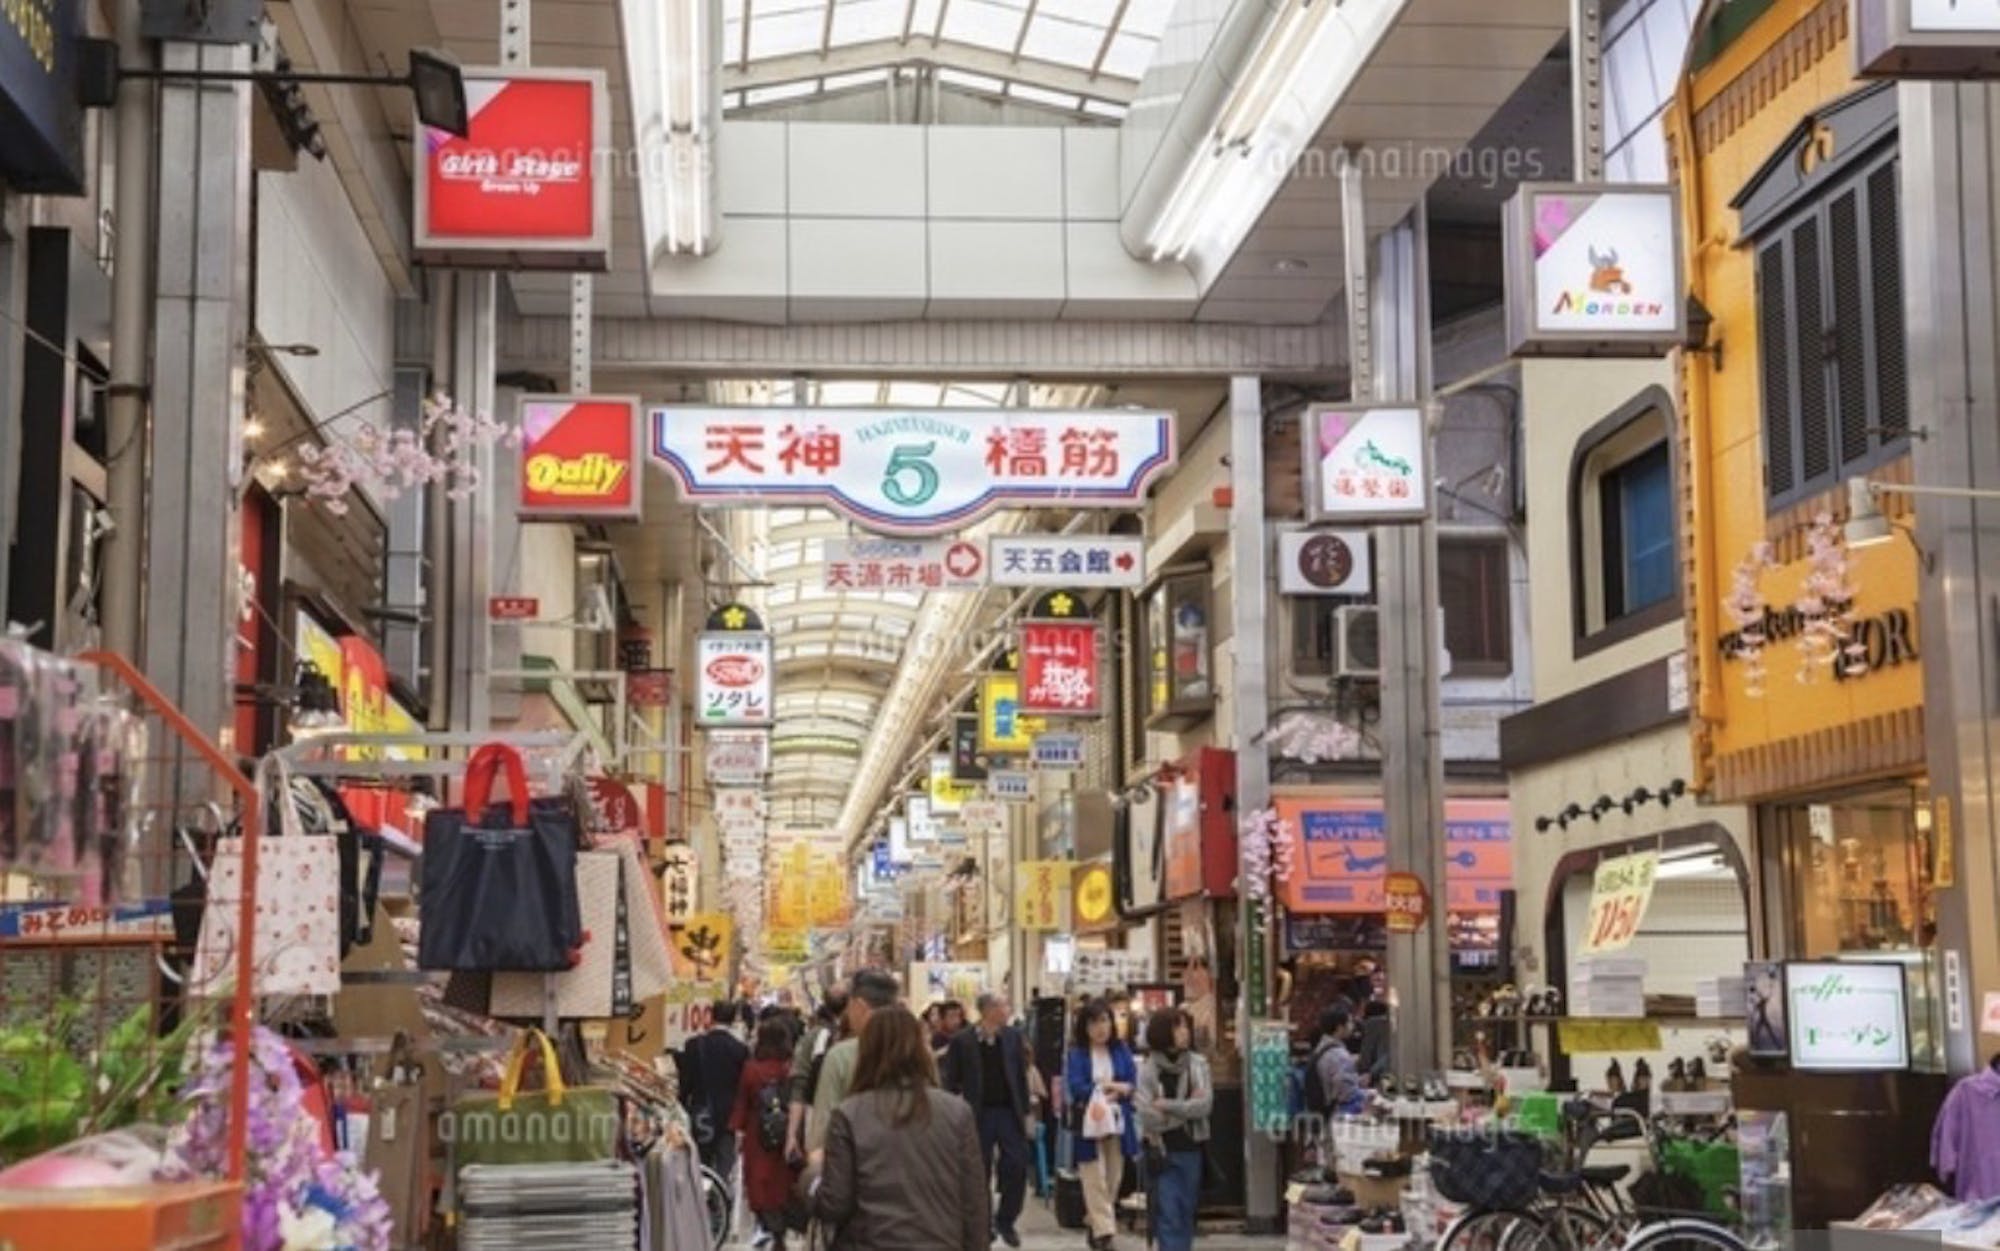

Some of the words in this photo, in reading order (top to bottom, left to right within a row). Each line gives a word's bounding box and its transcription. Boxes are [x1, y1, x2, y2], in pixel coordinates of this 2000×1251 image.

[706, 423, 841, 475] 天神
[881, 440, 938, 507] 5
[986, 426, 1119, 477] 橋筋
[1799, 973, 1853, 1001] coffee
